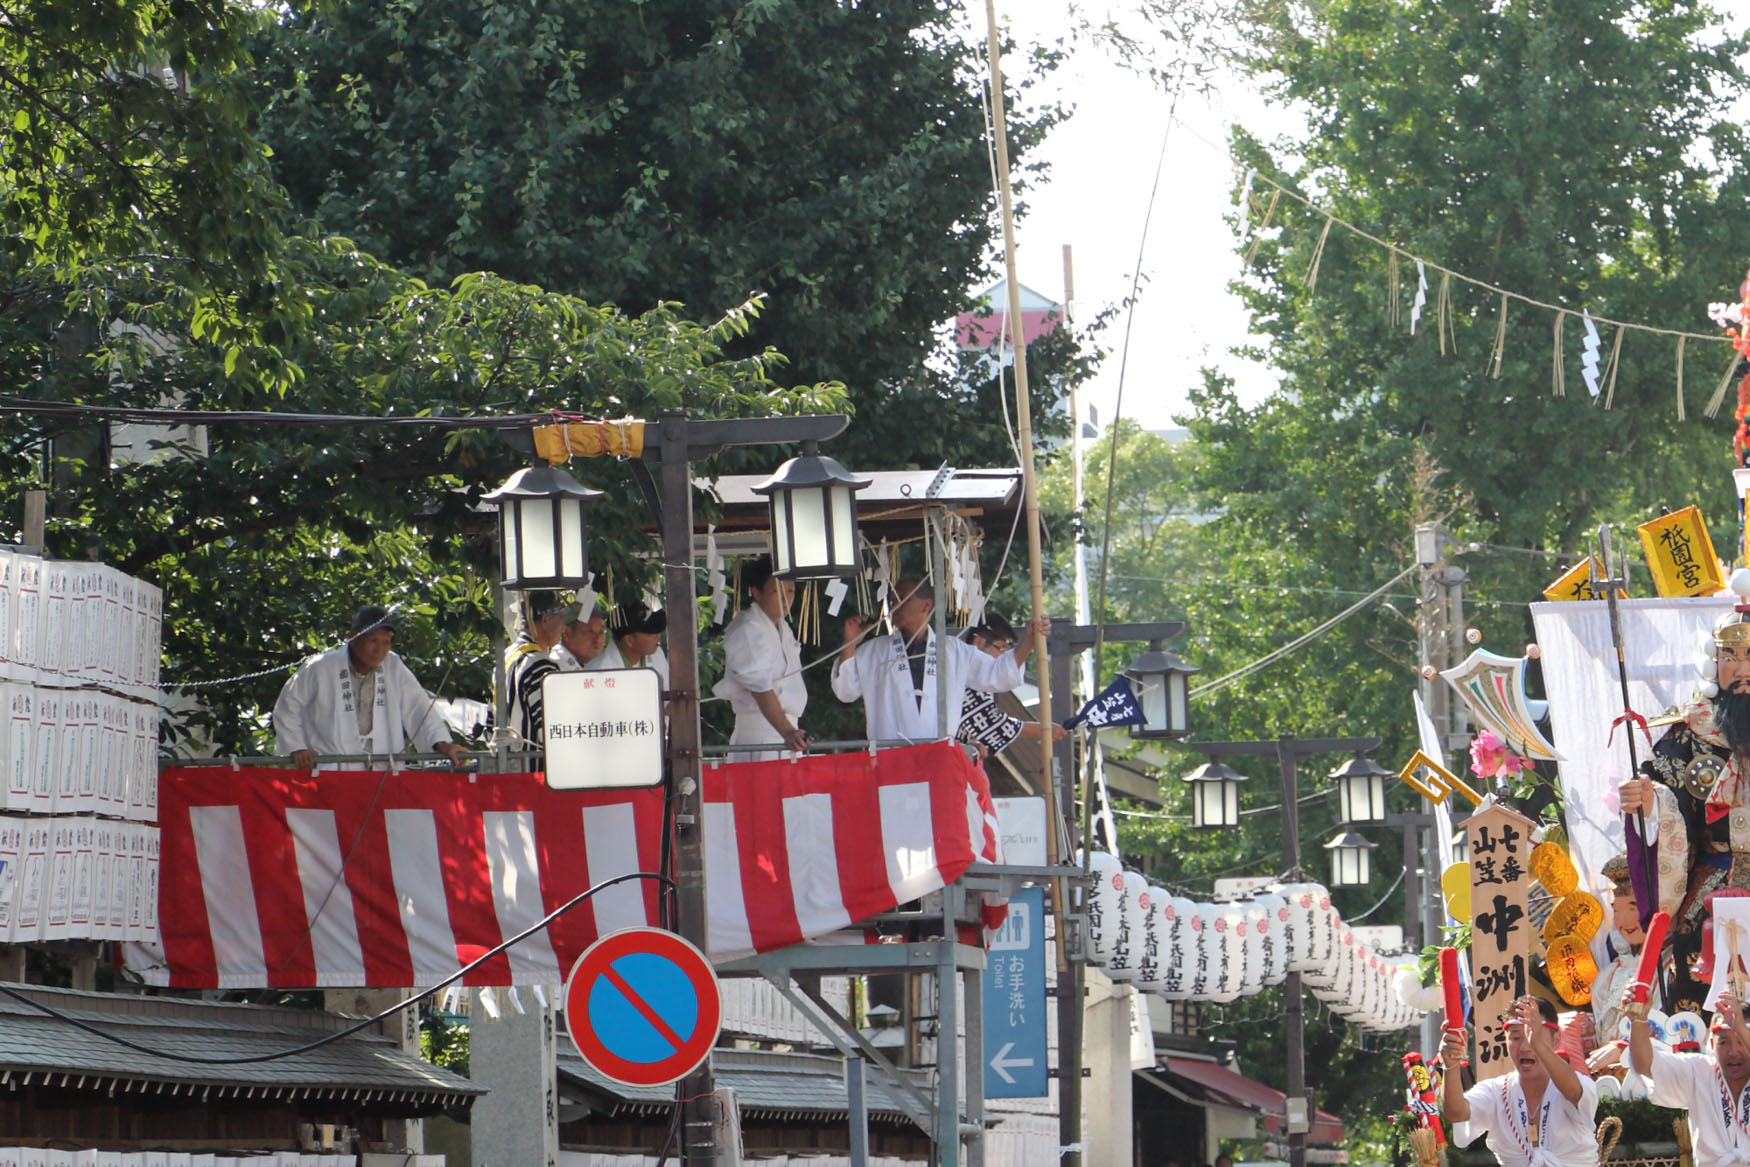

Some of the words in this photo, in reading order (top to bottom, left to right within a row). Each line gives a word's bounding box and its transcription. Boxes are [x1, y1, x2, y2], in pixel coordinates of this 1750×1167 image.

[1659, 527, 1702, 589] 祇園宮
[549, 719, 655, 740] 西日本自動車(株)
[1473, 825, 1503, 888] 山笠
[1498, 824, 1527, 884] 七番
[994, 956, 1005, 988] Toilet
[1008, 955, 1026, 1028] お手洗い
